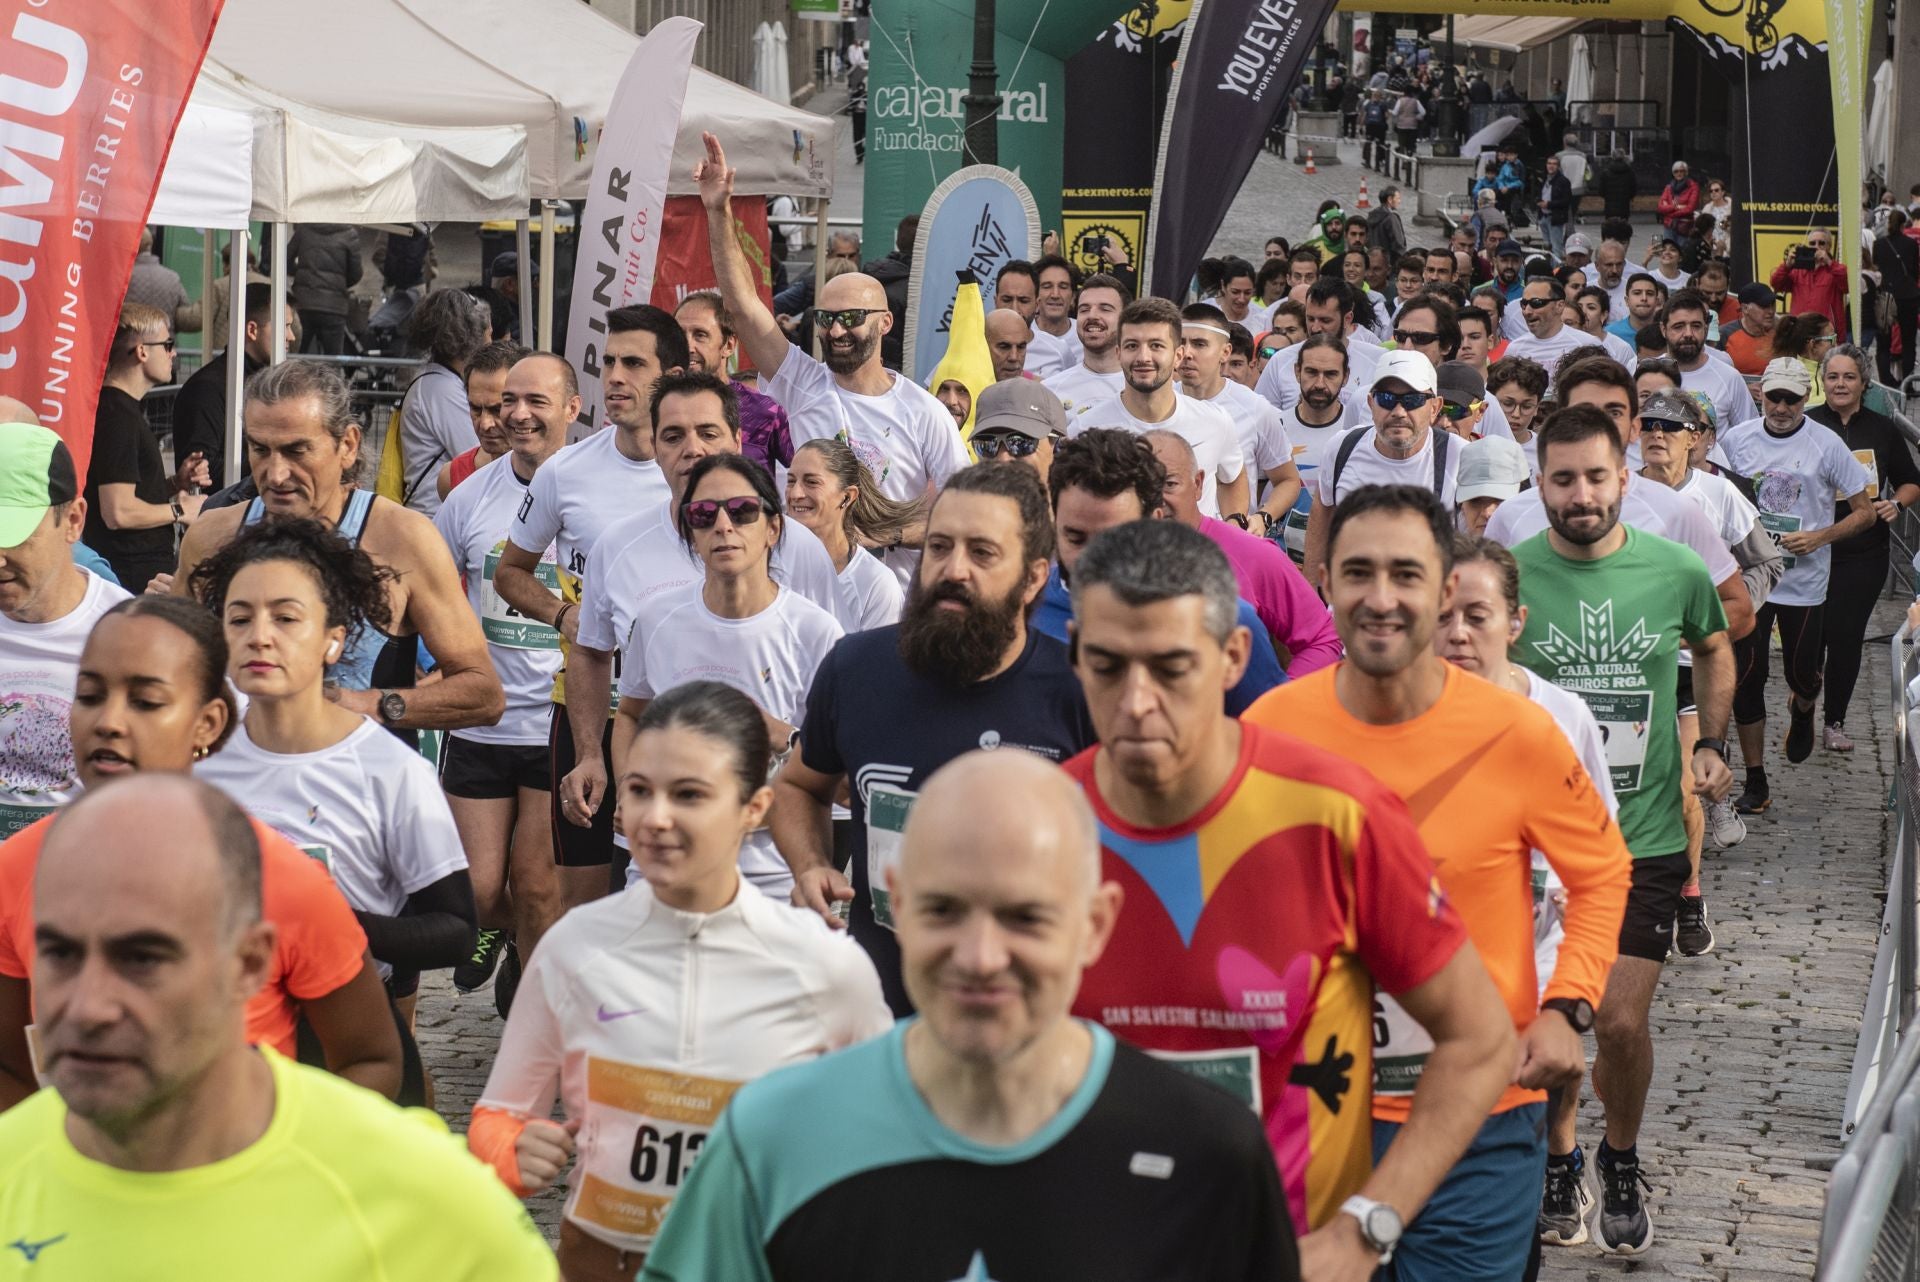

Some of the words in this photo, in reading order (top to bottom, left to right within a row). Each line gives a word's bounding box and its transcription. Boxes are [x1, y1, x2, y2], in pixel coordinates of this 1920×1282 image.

[1217, 44, 1266, 95] YOU
[1244, 0, 1298, 51] EVE
[1252, 65, 1277, 102] SPORTS
[1273, 17, 1303, 64] SERVICES
[874, 81, 1048, 127] cajarral
[1062, 188, 1152, 198] w.sexmeros.co
[1741, 202, 1838, 213] www.sexmeros.c
[630, 207, 648, 243] Co.
[39, 261, 82, 423] UNNING
[72, 63, 144, 244] BERRIES
[582, 166, 632, 379] PINAR
[620, 249, 641, 308] ruit
[527, 630, 560, 640] cajarural
[1558, 663, 1592, 676] CAJA
[1595, 662, 1642, 676] RURAL
[1612, 675, 1648, 689] RGA
[0, 807, 24, 819] rrera
[1103, 1006, 1130, 1025] SAN
[1132, 1005, 1198, 1028] SILVESTRE
[1201, 1009, 1287, 1030] SALMANTINA
